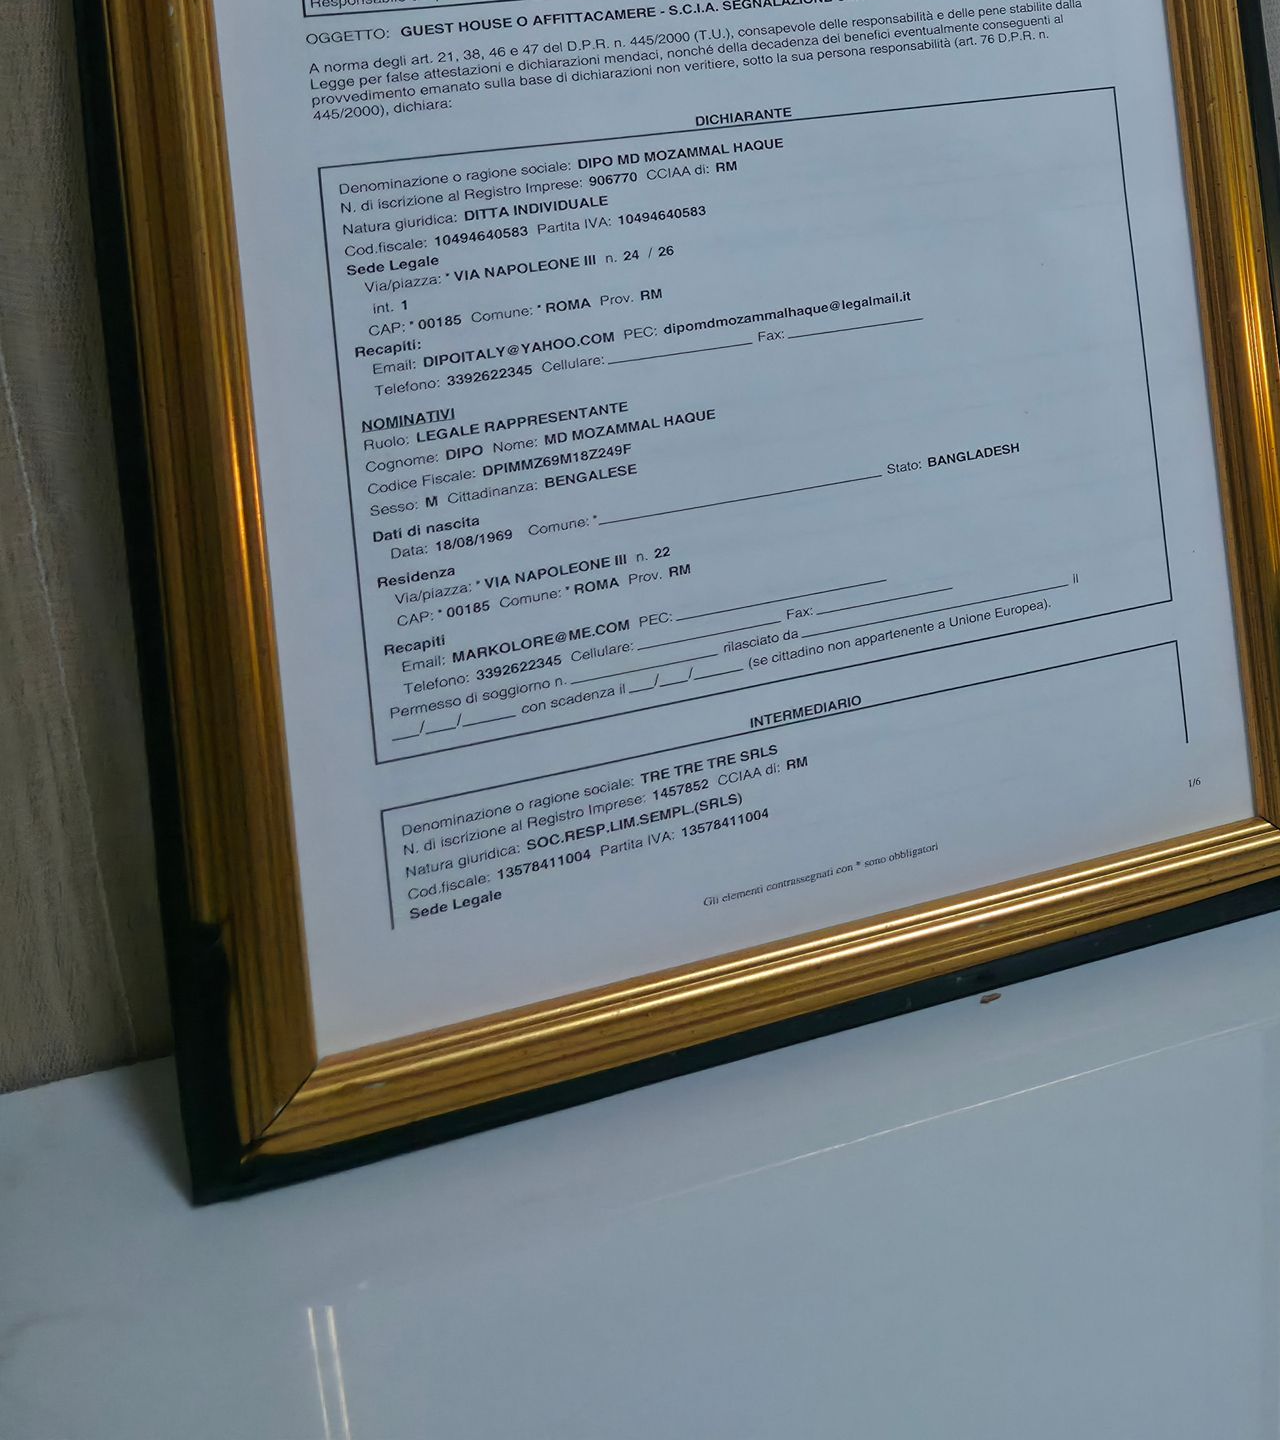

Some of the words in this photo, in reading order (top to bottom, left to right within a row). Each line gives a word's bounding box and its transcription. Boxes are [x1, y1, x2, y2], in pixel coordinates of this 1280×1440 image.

[305, 27, 390, 45] OGGETTO:
[400, 22, 455, 37] GUEST
[458, 17, 513, 33] HOUSE
[516, 15, 528, 28] O
[532, 6, 657, 26] AFFITTACAMERE
[668, 2, 719, 16] S.C.I.A.
[695, 106, 793, 127] DICHIARANTE
[339, 174, 449, 195] Denominazione
[452, 173, 462, 183] o
[466, 167, 518, 183] ragione
[520, 161, 571, 176] sociale:
[577, 155, 614, 170] DIPO
[617, 153, 641, 166] MD
[643, 143, 730, 163] MOZAMMAL
[733, 137, 784, 153] HAQUE
[342, 221, 391, 235] Natura
[394, 213, 458, 233] giuridica:
[464, 206, 510, 222] DITTA
[513, 195, 609, 216] INDIVIDUALE
[344, 238, 428, 257] Cod.fiscale:
[434, 225, 529, 247] 10494640583
[537, 221, 581, 235] Partita
[584, 216, 612, 229] IVA:
[617, 205, 707, 225] 10494640583
[346, 262, 385, 277] Sede
[389, 255, 440, 272] Legale
[364, 275, 441, 293] Via/piazza:
[453, 268, 481, 282] VIA
[484, 256, 581, 279] NAPOLEONE
[583, 254, 597, 266] III
[605, 254, 617, 264] n.
[623, 249, 640, 262] 24
[658, 245, 675, 258] 26
[368, 321, 405, 337] CAP:
[417, 314, 462, 330] 00185
[471, 307, 533, 323] Comune:
[545, 297, 592, 314] ROMA
[599, 294, 634, 306] Prov.
[640, 288, 663, 301] RM
[373, 302, 394, 315] int.
[401, 299, 408, 311] 1
[354, 339, 422, 358] Recapiti:
[372, 359, 416, 375] Email:
[423, 331, 615, 368] DIPOITALY@YAHOO.COM
[623, 326, 658, 340] PEC:
[374, 379, 441, 396] Telefono:
[446, 364, 533, 387] 3392622345
[541, 356, 605, 373] Cellulare:
[757, 330, 785, 342] Fax:
[361, 407, 455, 434] NOMINATIVI
[363, 436, 410, 451] Ruolo:
[416, 423, 480, 443] LEGALE
[484, 401, 629, 433] RAPPRESENTANTE
[365, 453, 439, 473] Cognome:
[445, 444, 484, 461] DIPO
[492, 438, 538, 454] Nome:
[544, 431, 568, 446] MD
[571, 418, 661, 441] MOZAMMAL
[663, 408, 716, 428] HAQUE
[887, 460, 923, 475] Stato:
[927, 442, 1020, 468] BANGLADESH
[749, 695, 862, 729] INTERMEDIARIO
[401, 804, 512, 837] Denominazione
[515, 802, 525, 812] o
[528, 790, 580, 809] ragione
[583, 778, 635, 797] sociale:
[639, 767, 671, 784] TRE
[673, 760, 704, 777] TRE
[706, 752, 737, 769] TRE
[739, 744, 778, 762] SRLS
[1188, 776, 1201, 788] 1/6
[721, 886, 764, 903] elementi
[766, 869, 834, 892] contrassegnati
[835, 864, 853, 874] con
[864, 856, 887, 868] sono
[888, 842, 938, 862] obbligatori
